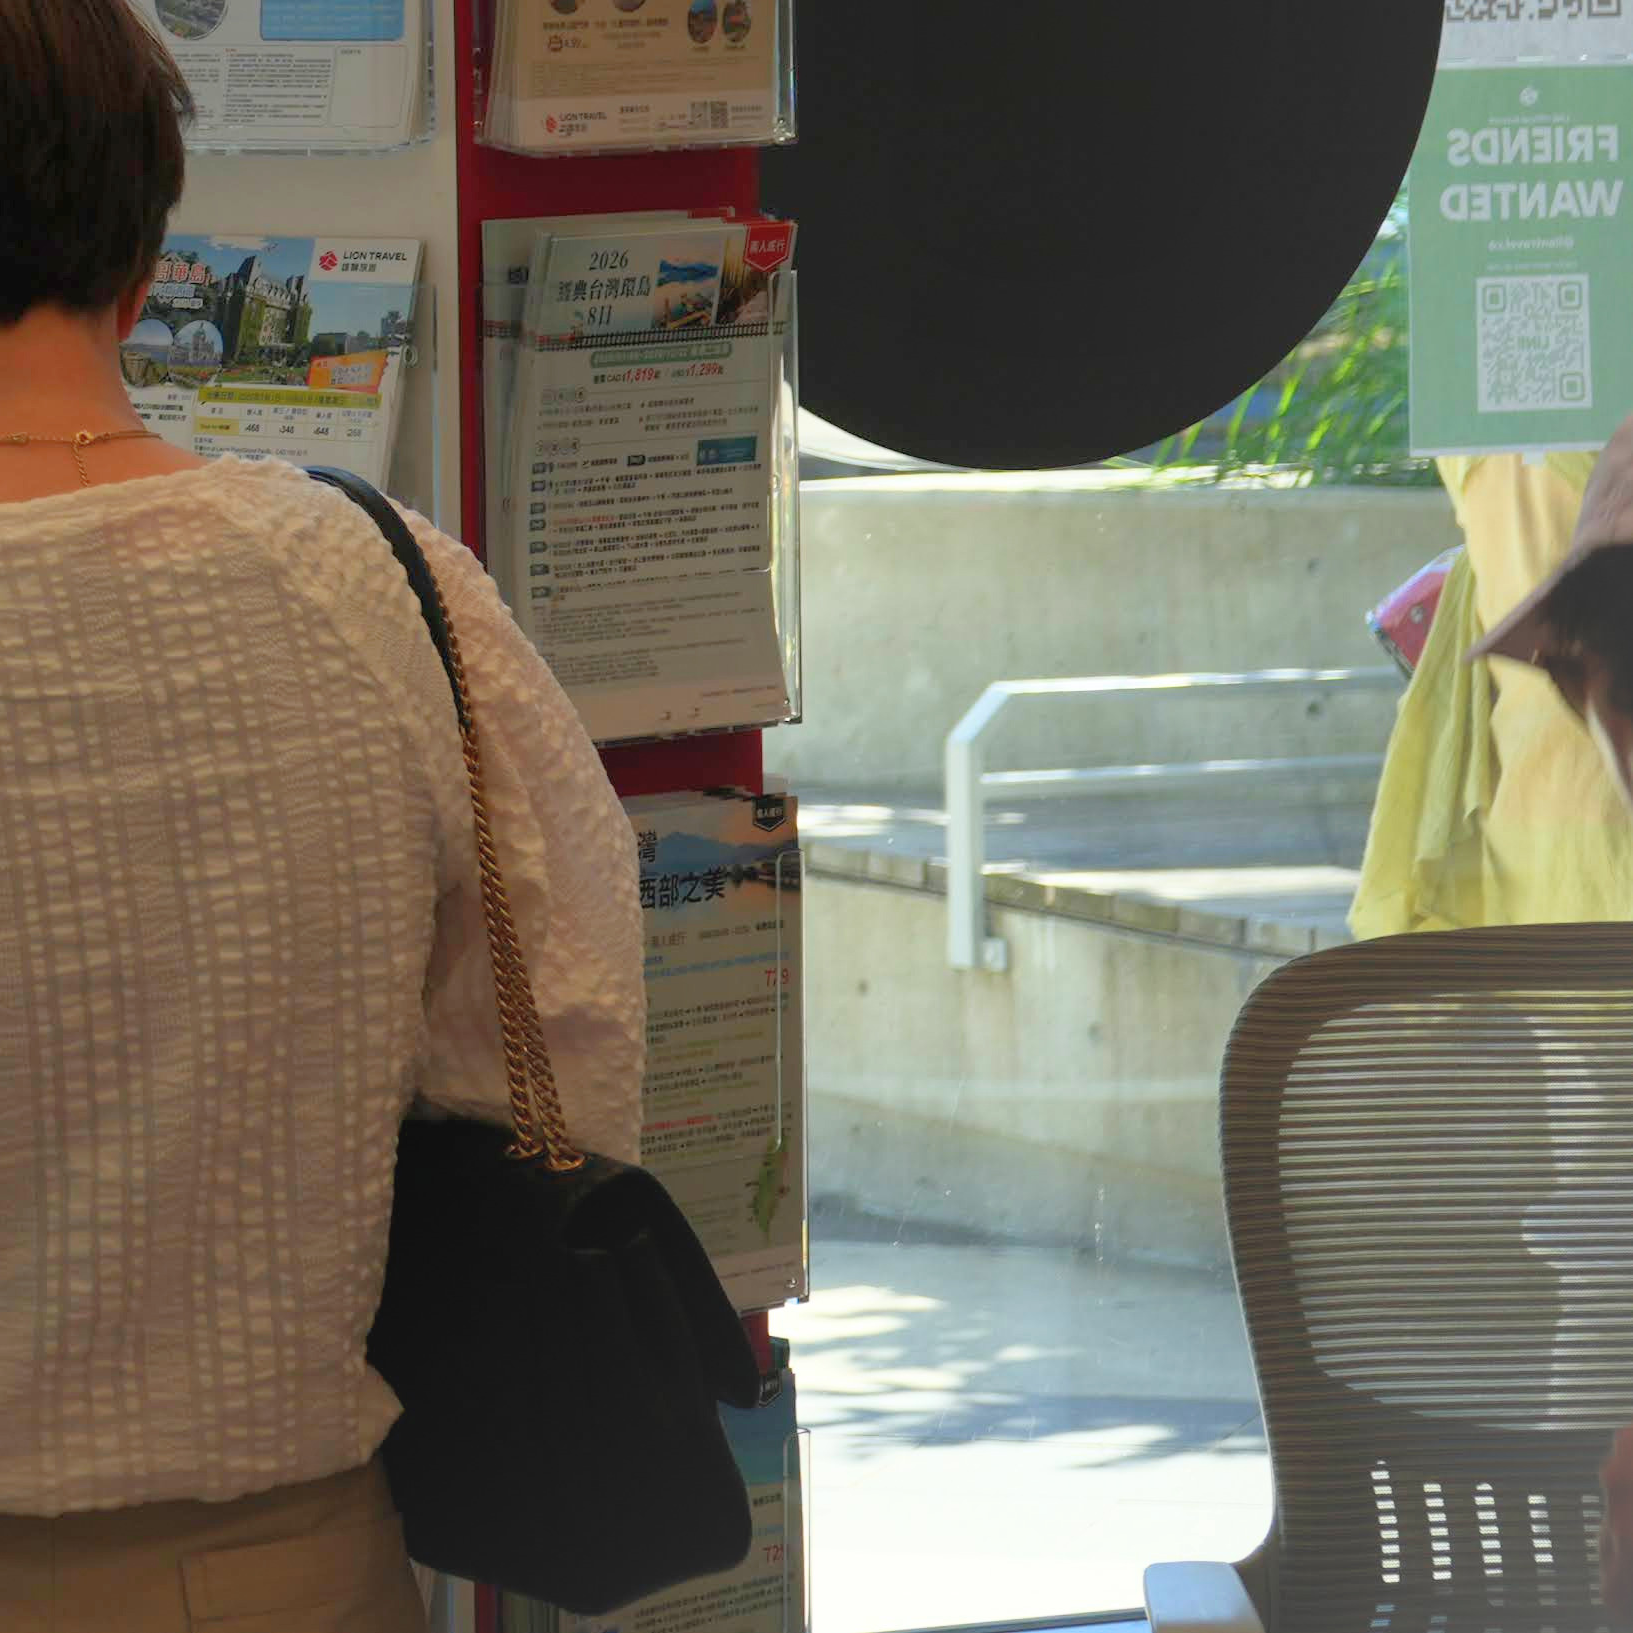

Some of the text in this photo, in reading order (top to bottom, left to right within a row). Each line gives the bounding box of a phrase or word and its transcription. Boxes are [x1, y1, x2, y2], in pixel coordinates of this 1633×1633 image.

[342, 250, 407, 262] LION TRAVEL
[587, 248, 630, 272] 2026
